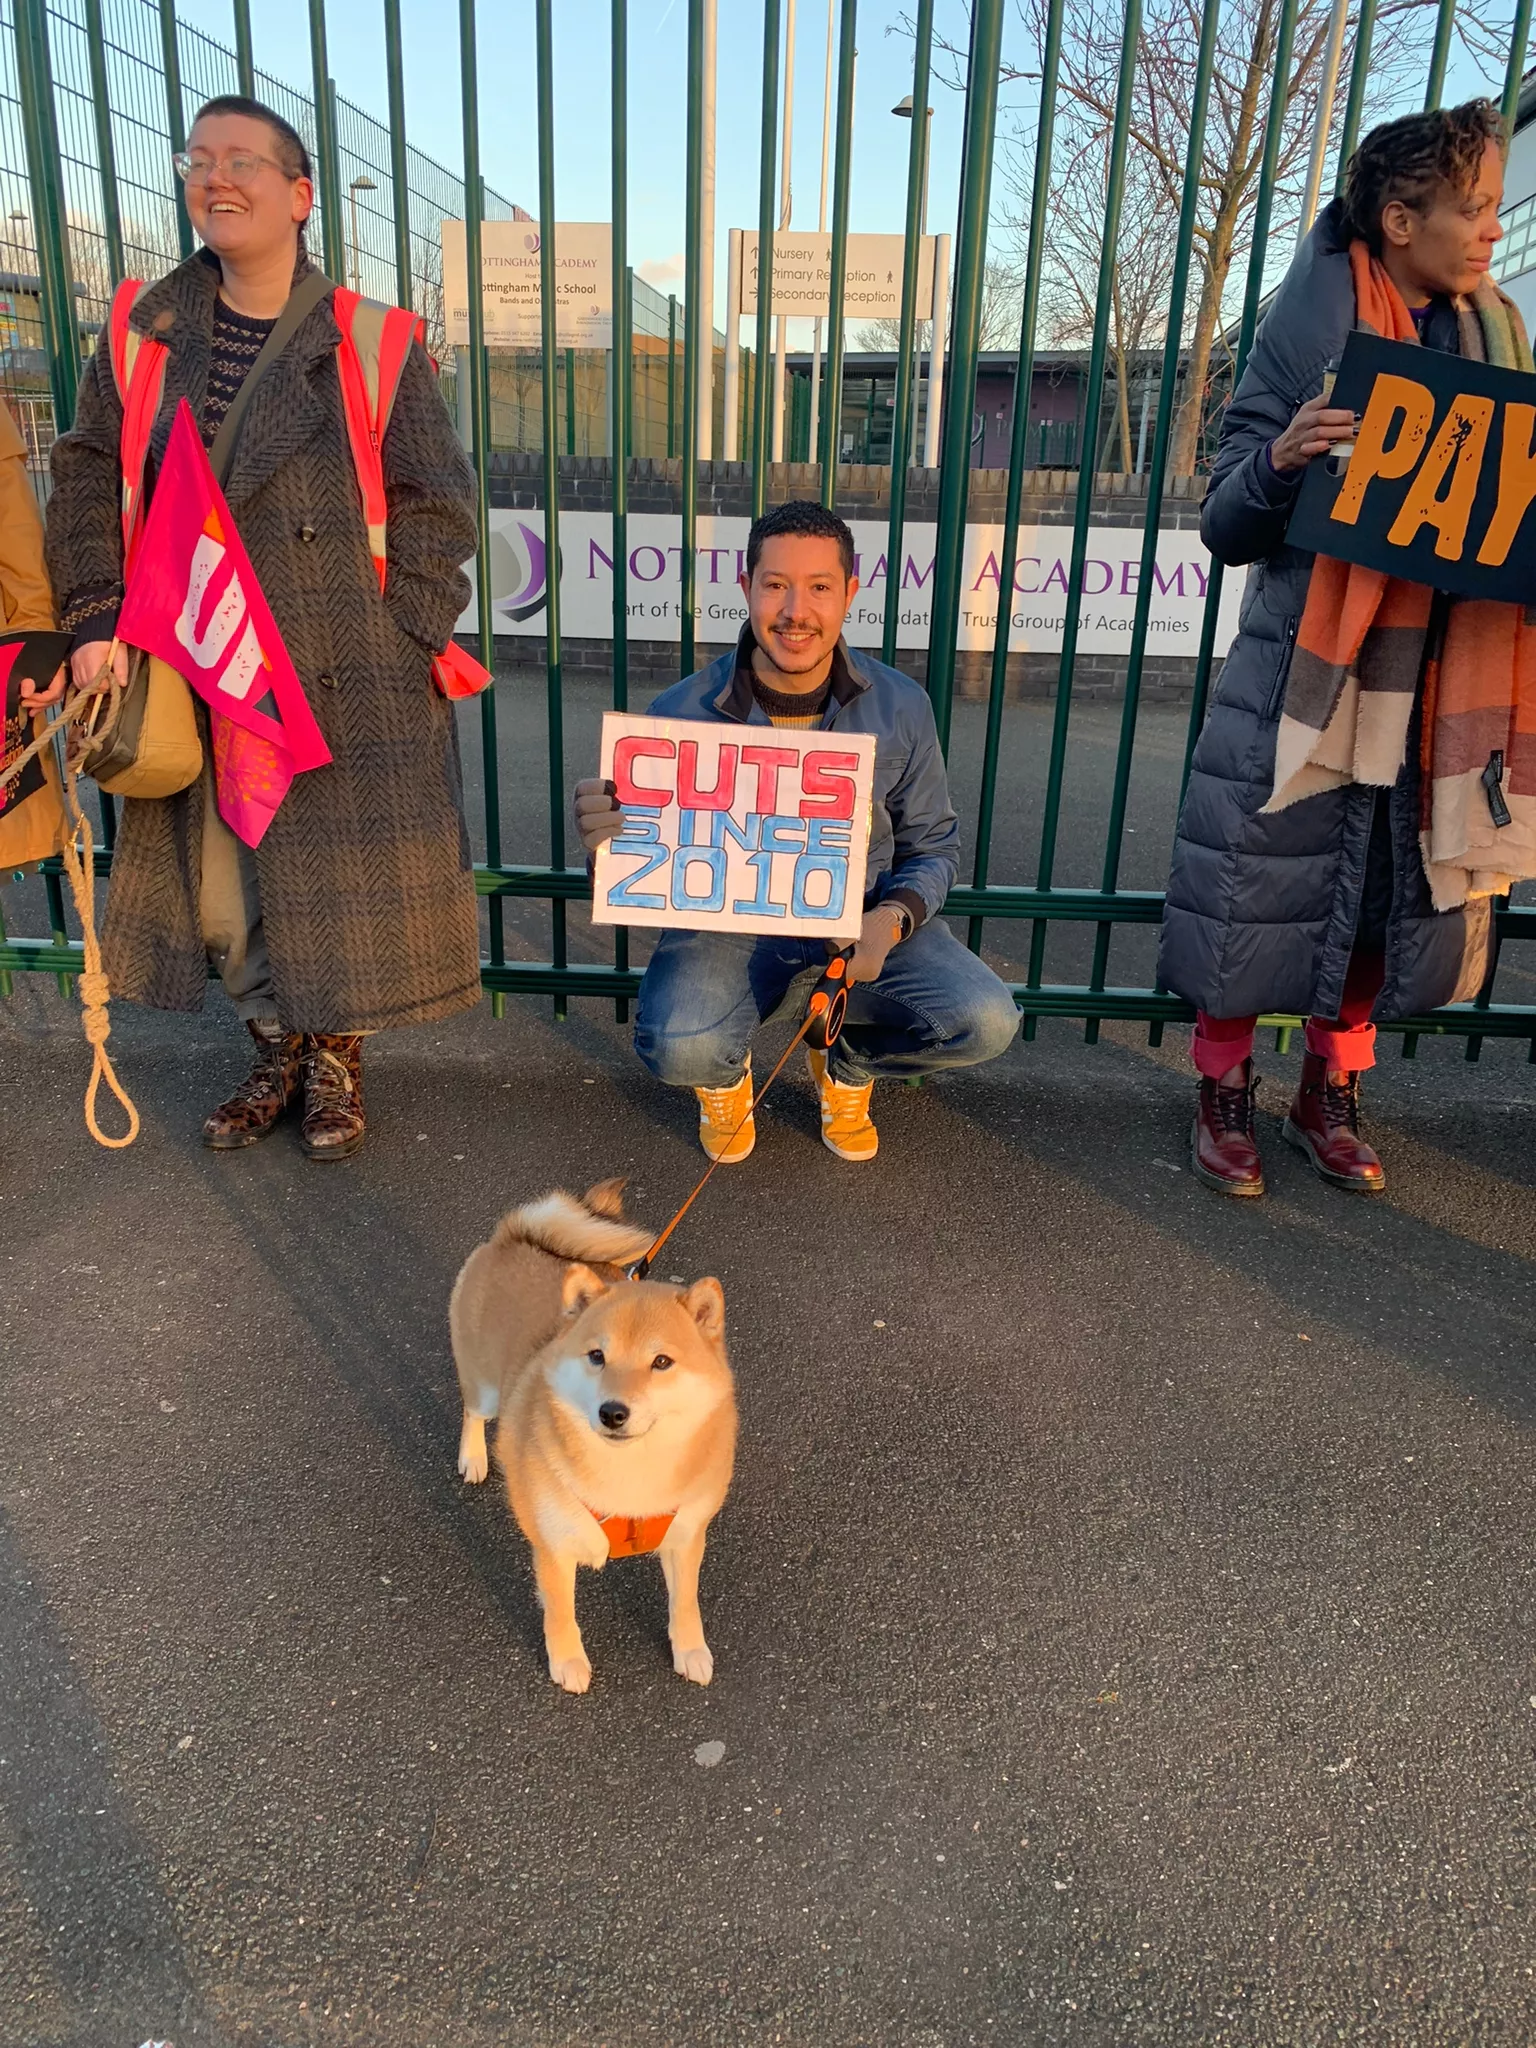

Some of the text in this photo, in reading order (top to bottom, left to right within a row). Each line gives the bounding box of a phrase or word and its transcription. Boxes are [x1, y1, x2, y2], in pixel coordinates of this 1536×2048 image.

[555, 258, 597, 268] CADEMY
[772, 247, 814, 262] Nursery
[771, 267, 876, 283] Primary Reption
[482, 282, 530, 294] ottingham
[564, 283, 596, 294] School
[499, 296, 520, 304] Bands
[521, 296, 534, 304] and
[843, 291, 896, 304] eception
[1329, 372, 1536, 566] PAY
[969, 549, 1210, 598] ACADEMY
[650, 600, 669, 618] of
[674, 603, 702, 619] te
[962, 611, 999, 627] Trus
[1011, 612, 1065, 633] Group
[612, 735, 861, 820] CUTS
[611, 804, 854, 857] SINCE
[606, 842, 850, 921] 2010
